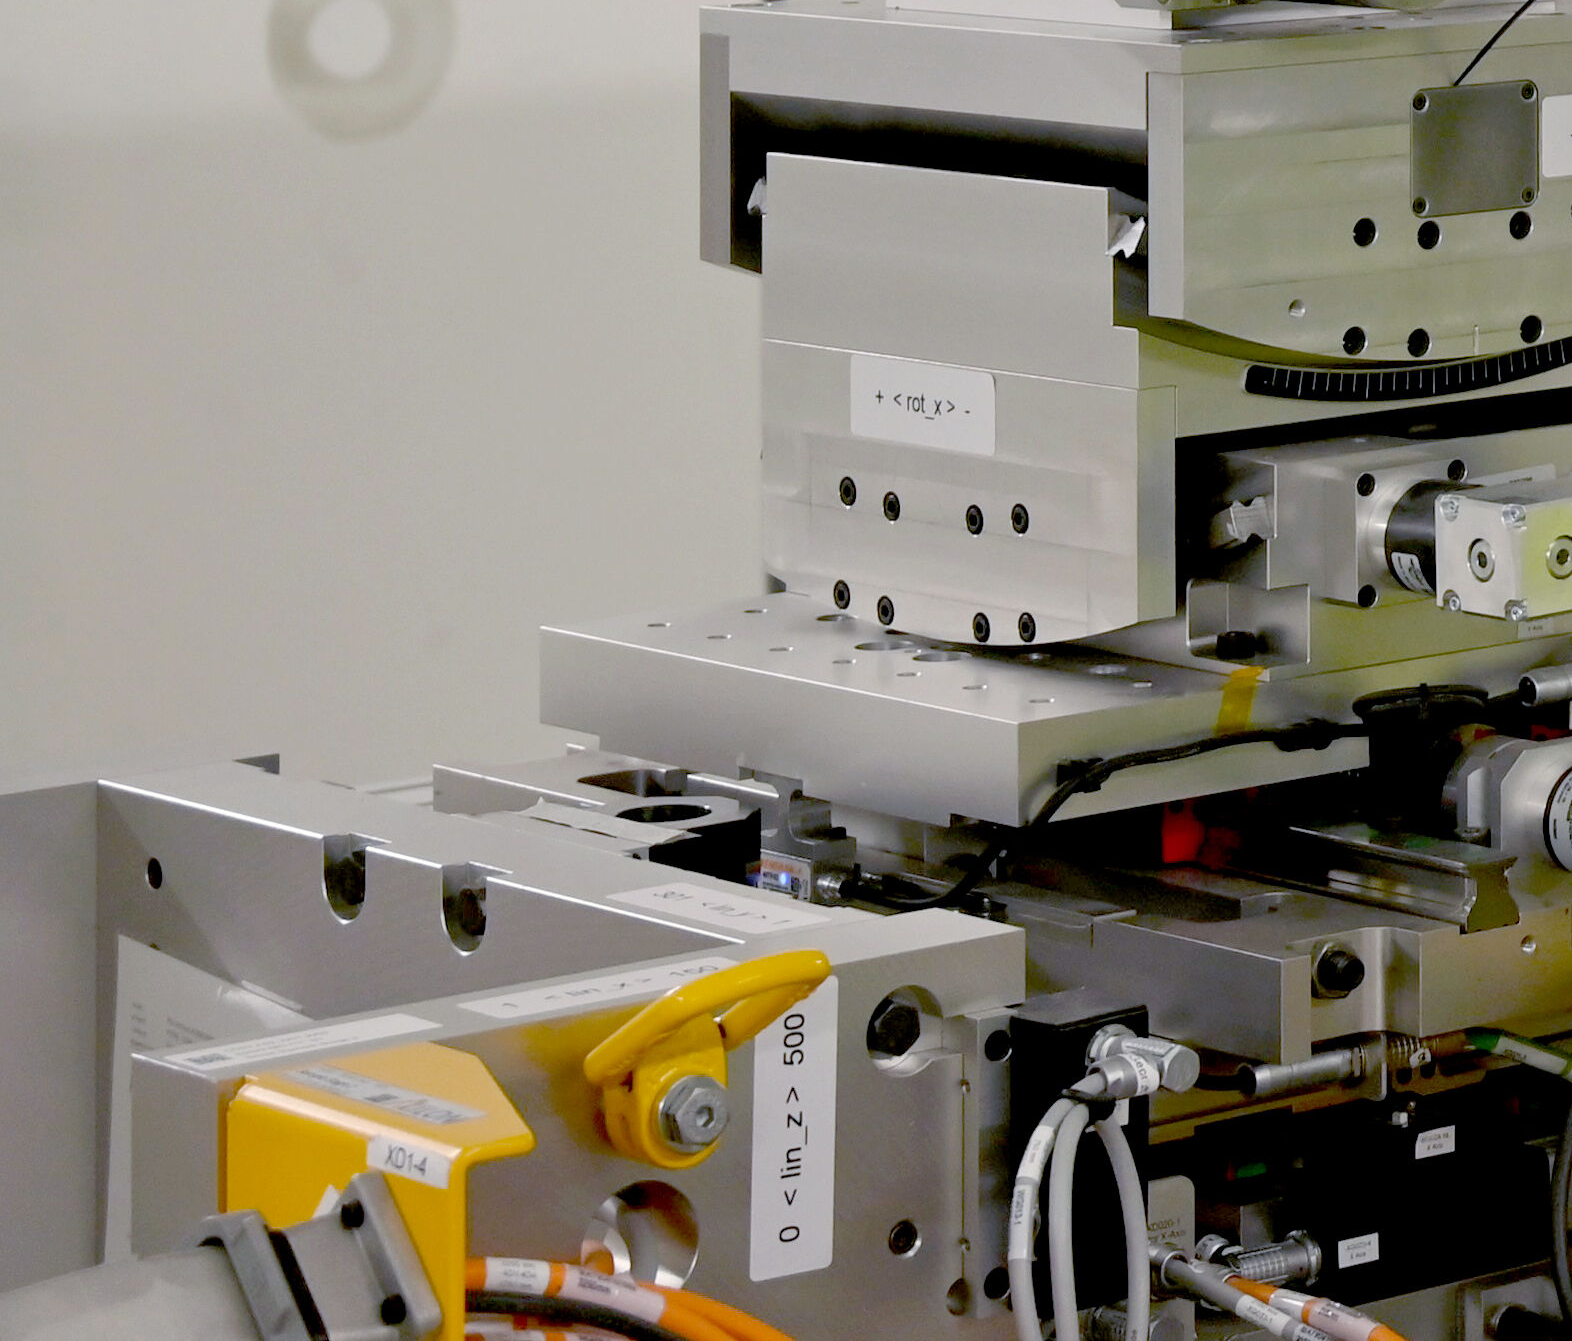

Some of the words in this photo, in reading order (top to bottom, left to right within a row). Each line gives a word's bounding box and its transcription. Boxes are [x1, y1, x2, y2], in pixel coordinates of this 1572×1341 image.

[906, 393, 943, 420] rot_x
[783, 1013, 805, 1066] 500
[780, 1111, 808, 1179] lin_z
[779, 1225, 801, 1243] 0
